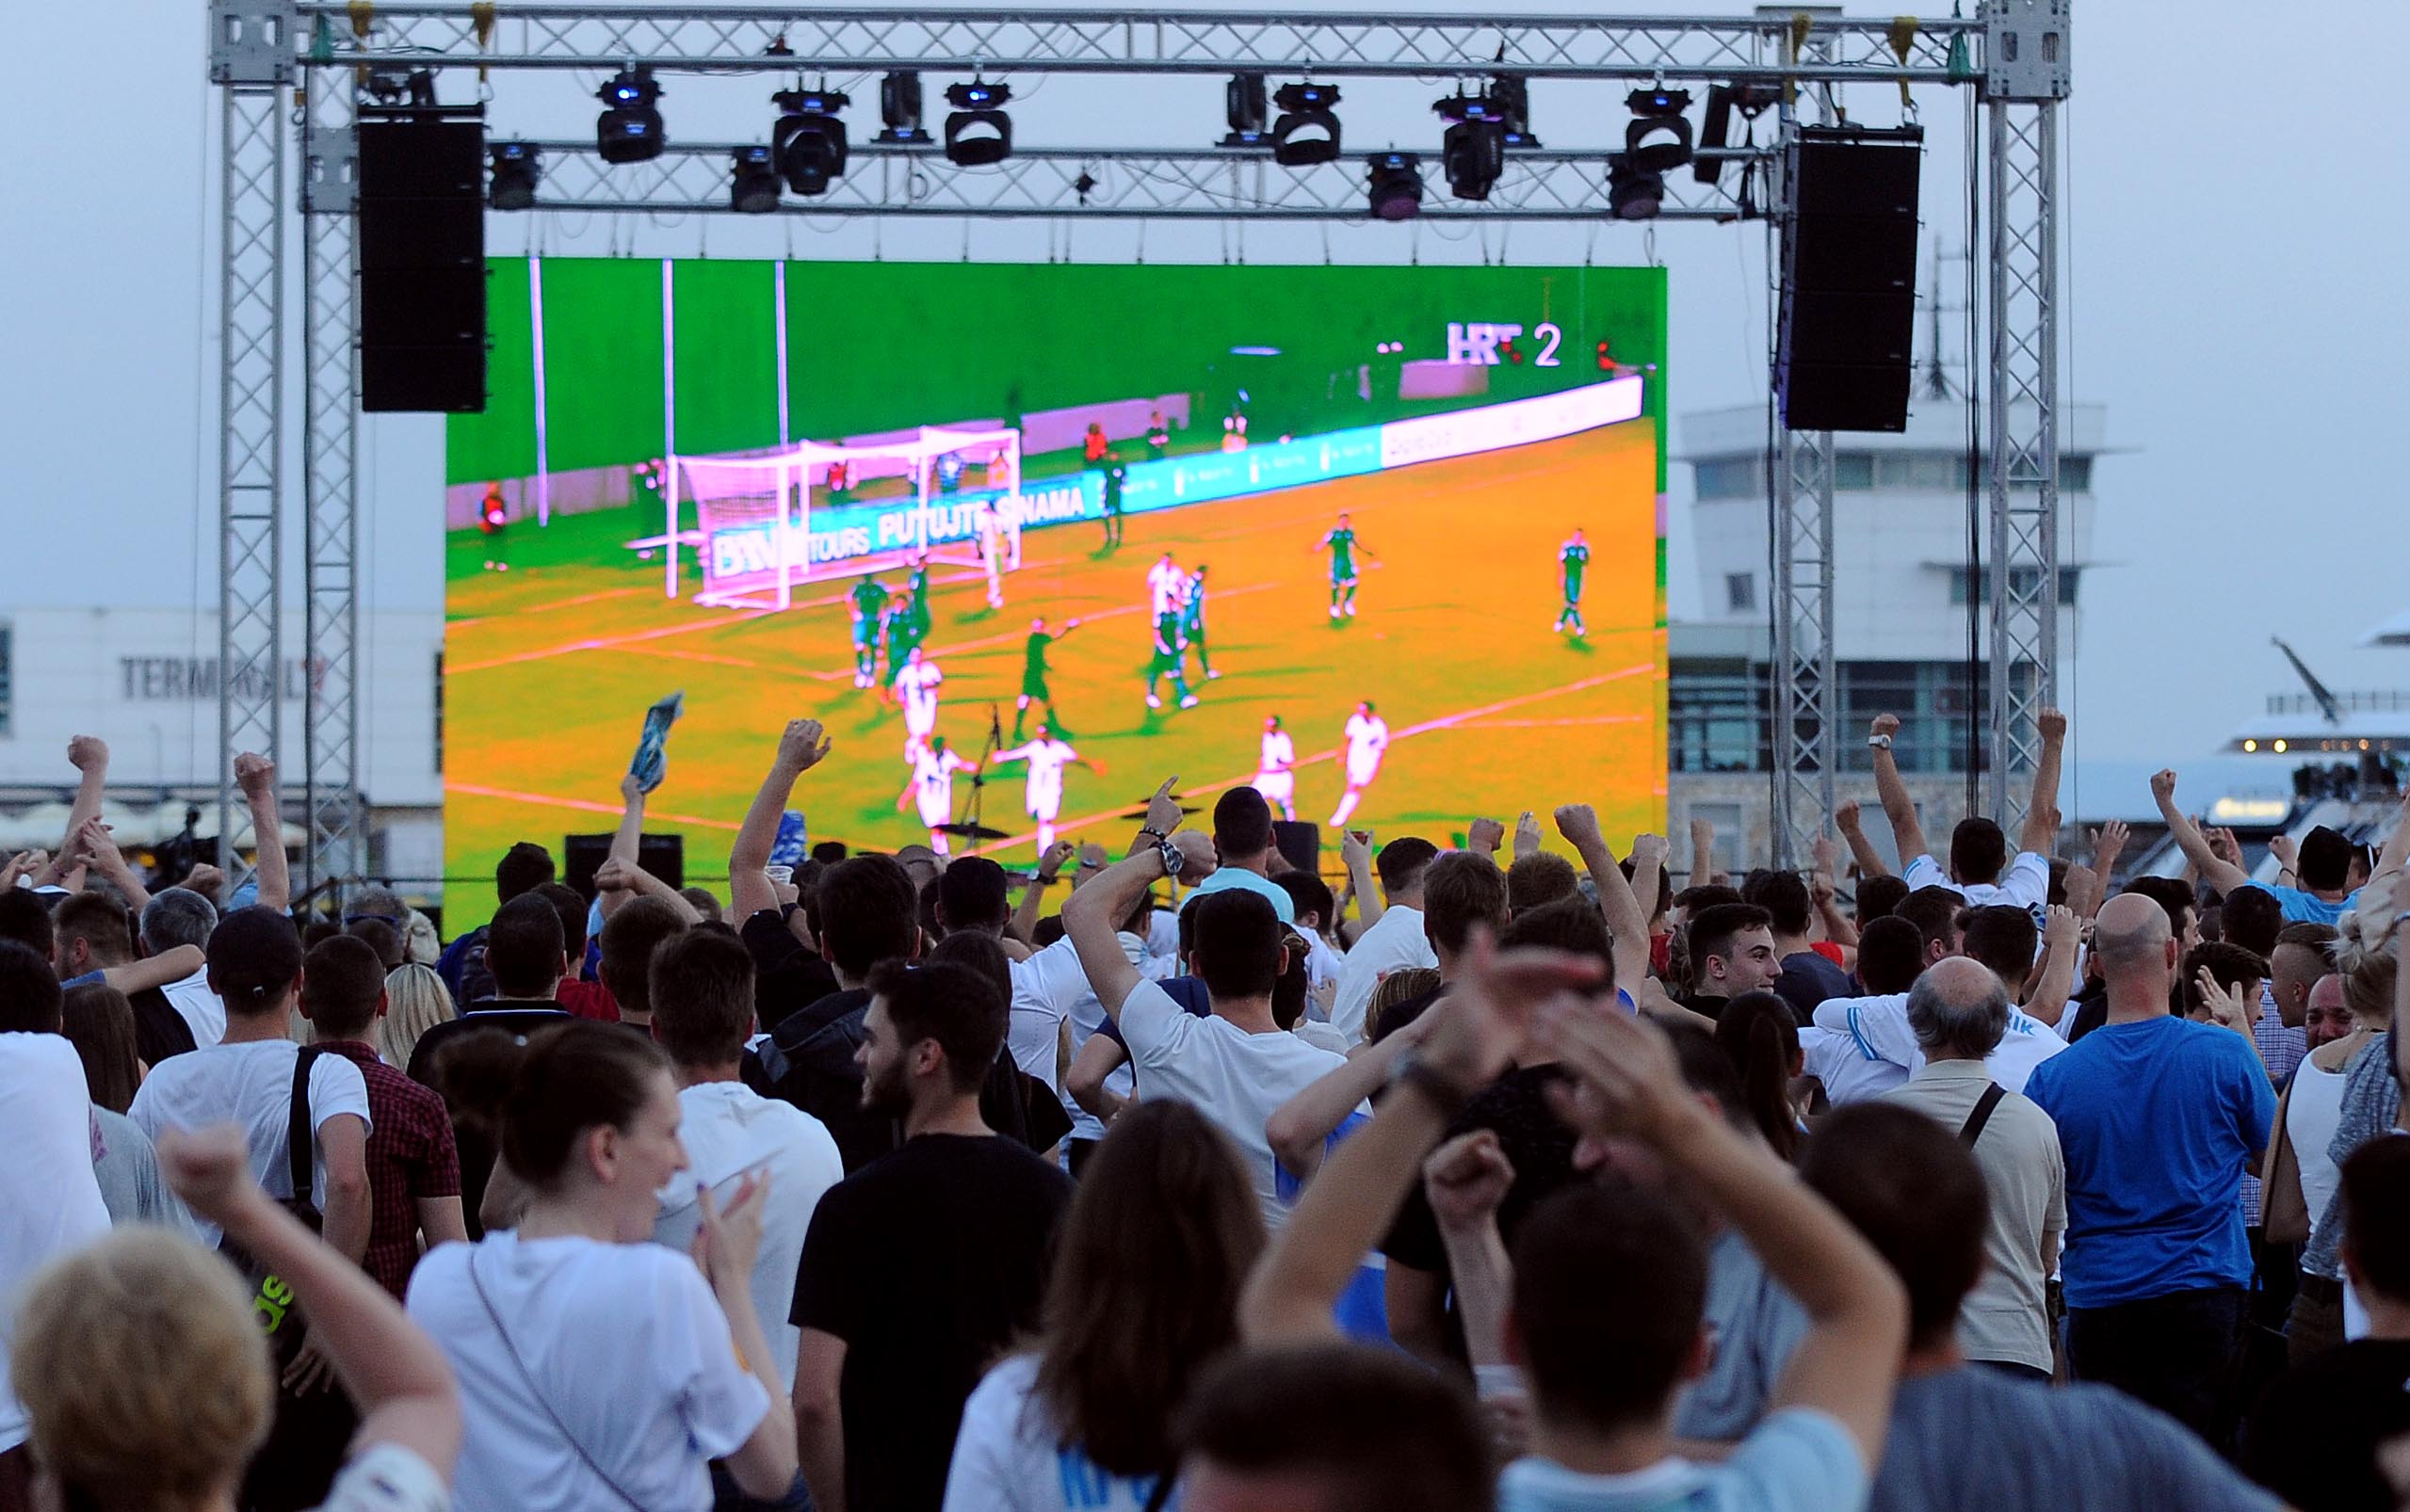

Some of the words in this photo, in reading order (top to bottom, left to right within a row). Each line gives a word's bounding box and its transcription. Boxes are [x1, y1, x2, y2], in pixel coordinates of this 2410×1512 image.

[1448, 322, 1523, 365] HRT
[1534, 322, 1561, 366] 2
[1017, 487, 1085, 523] NAMA
